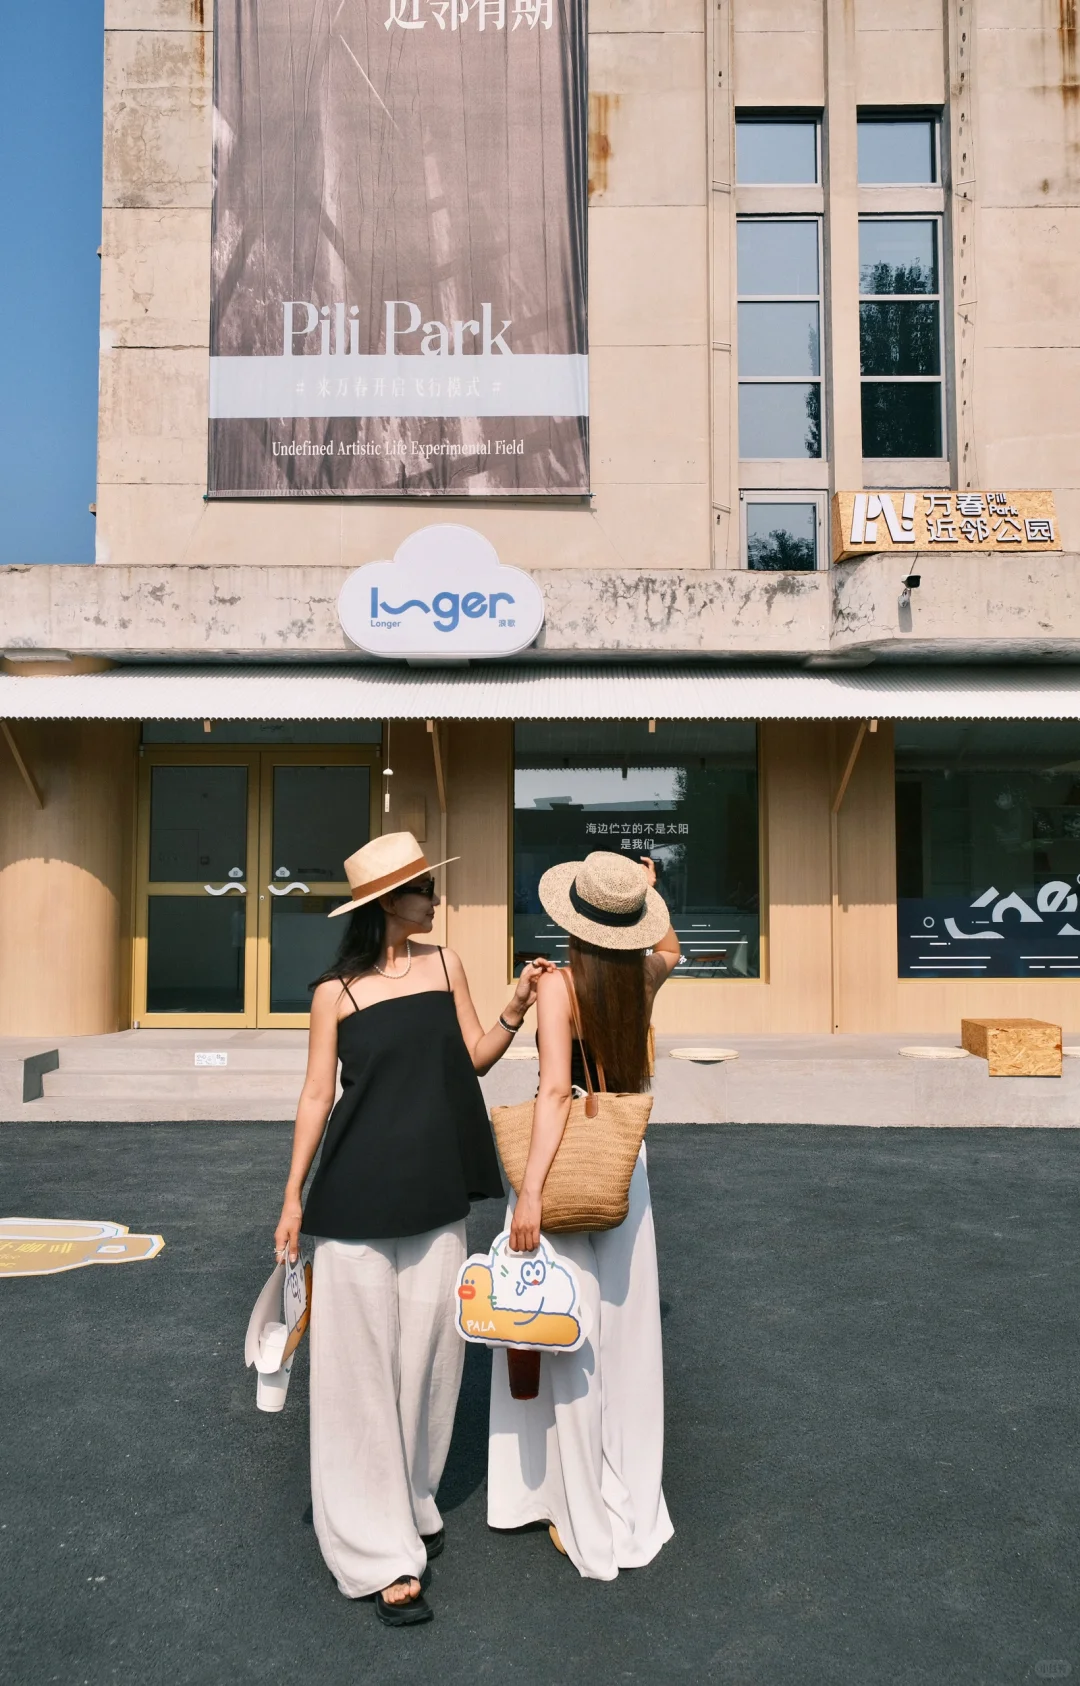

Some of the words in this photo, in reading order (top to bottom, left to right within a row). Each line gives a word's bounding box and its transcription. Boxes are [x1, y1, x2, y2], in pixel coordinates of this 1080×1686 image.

[282, 301, 360, 356] Pili
[384, 300, 514, 356] Park
[316, 376, 480, 398] 来万春开启飞行模式
[272, 440, 334, 456] Undefined
[337, 440, 381, 456] Artistic
[385, 439, 407, 456] Life
[411, 439, 491, 459] Experimental
[495, 439, 524, 455] Field
[923, 494, 986, 517] 万春
[988, 504, 1019, 517] Park
[927, 518, 1054, 543] 近邻公园
[370, 620, 401, 629] Longer
[585, 823, 689, 835] 海边伫立的不是太阳
[620, 838, 655, 850] 是我们
[466, 1319, 496, 1332] PALA
